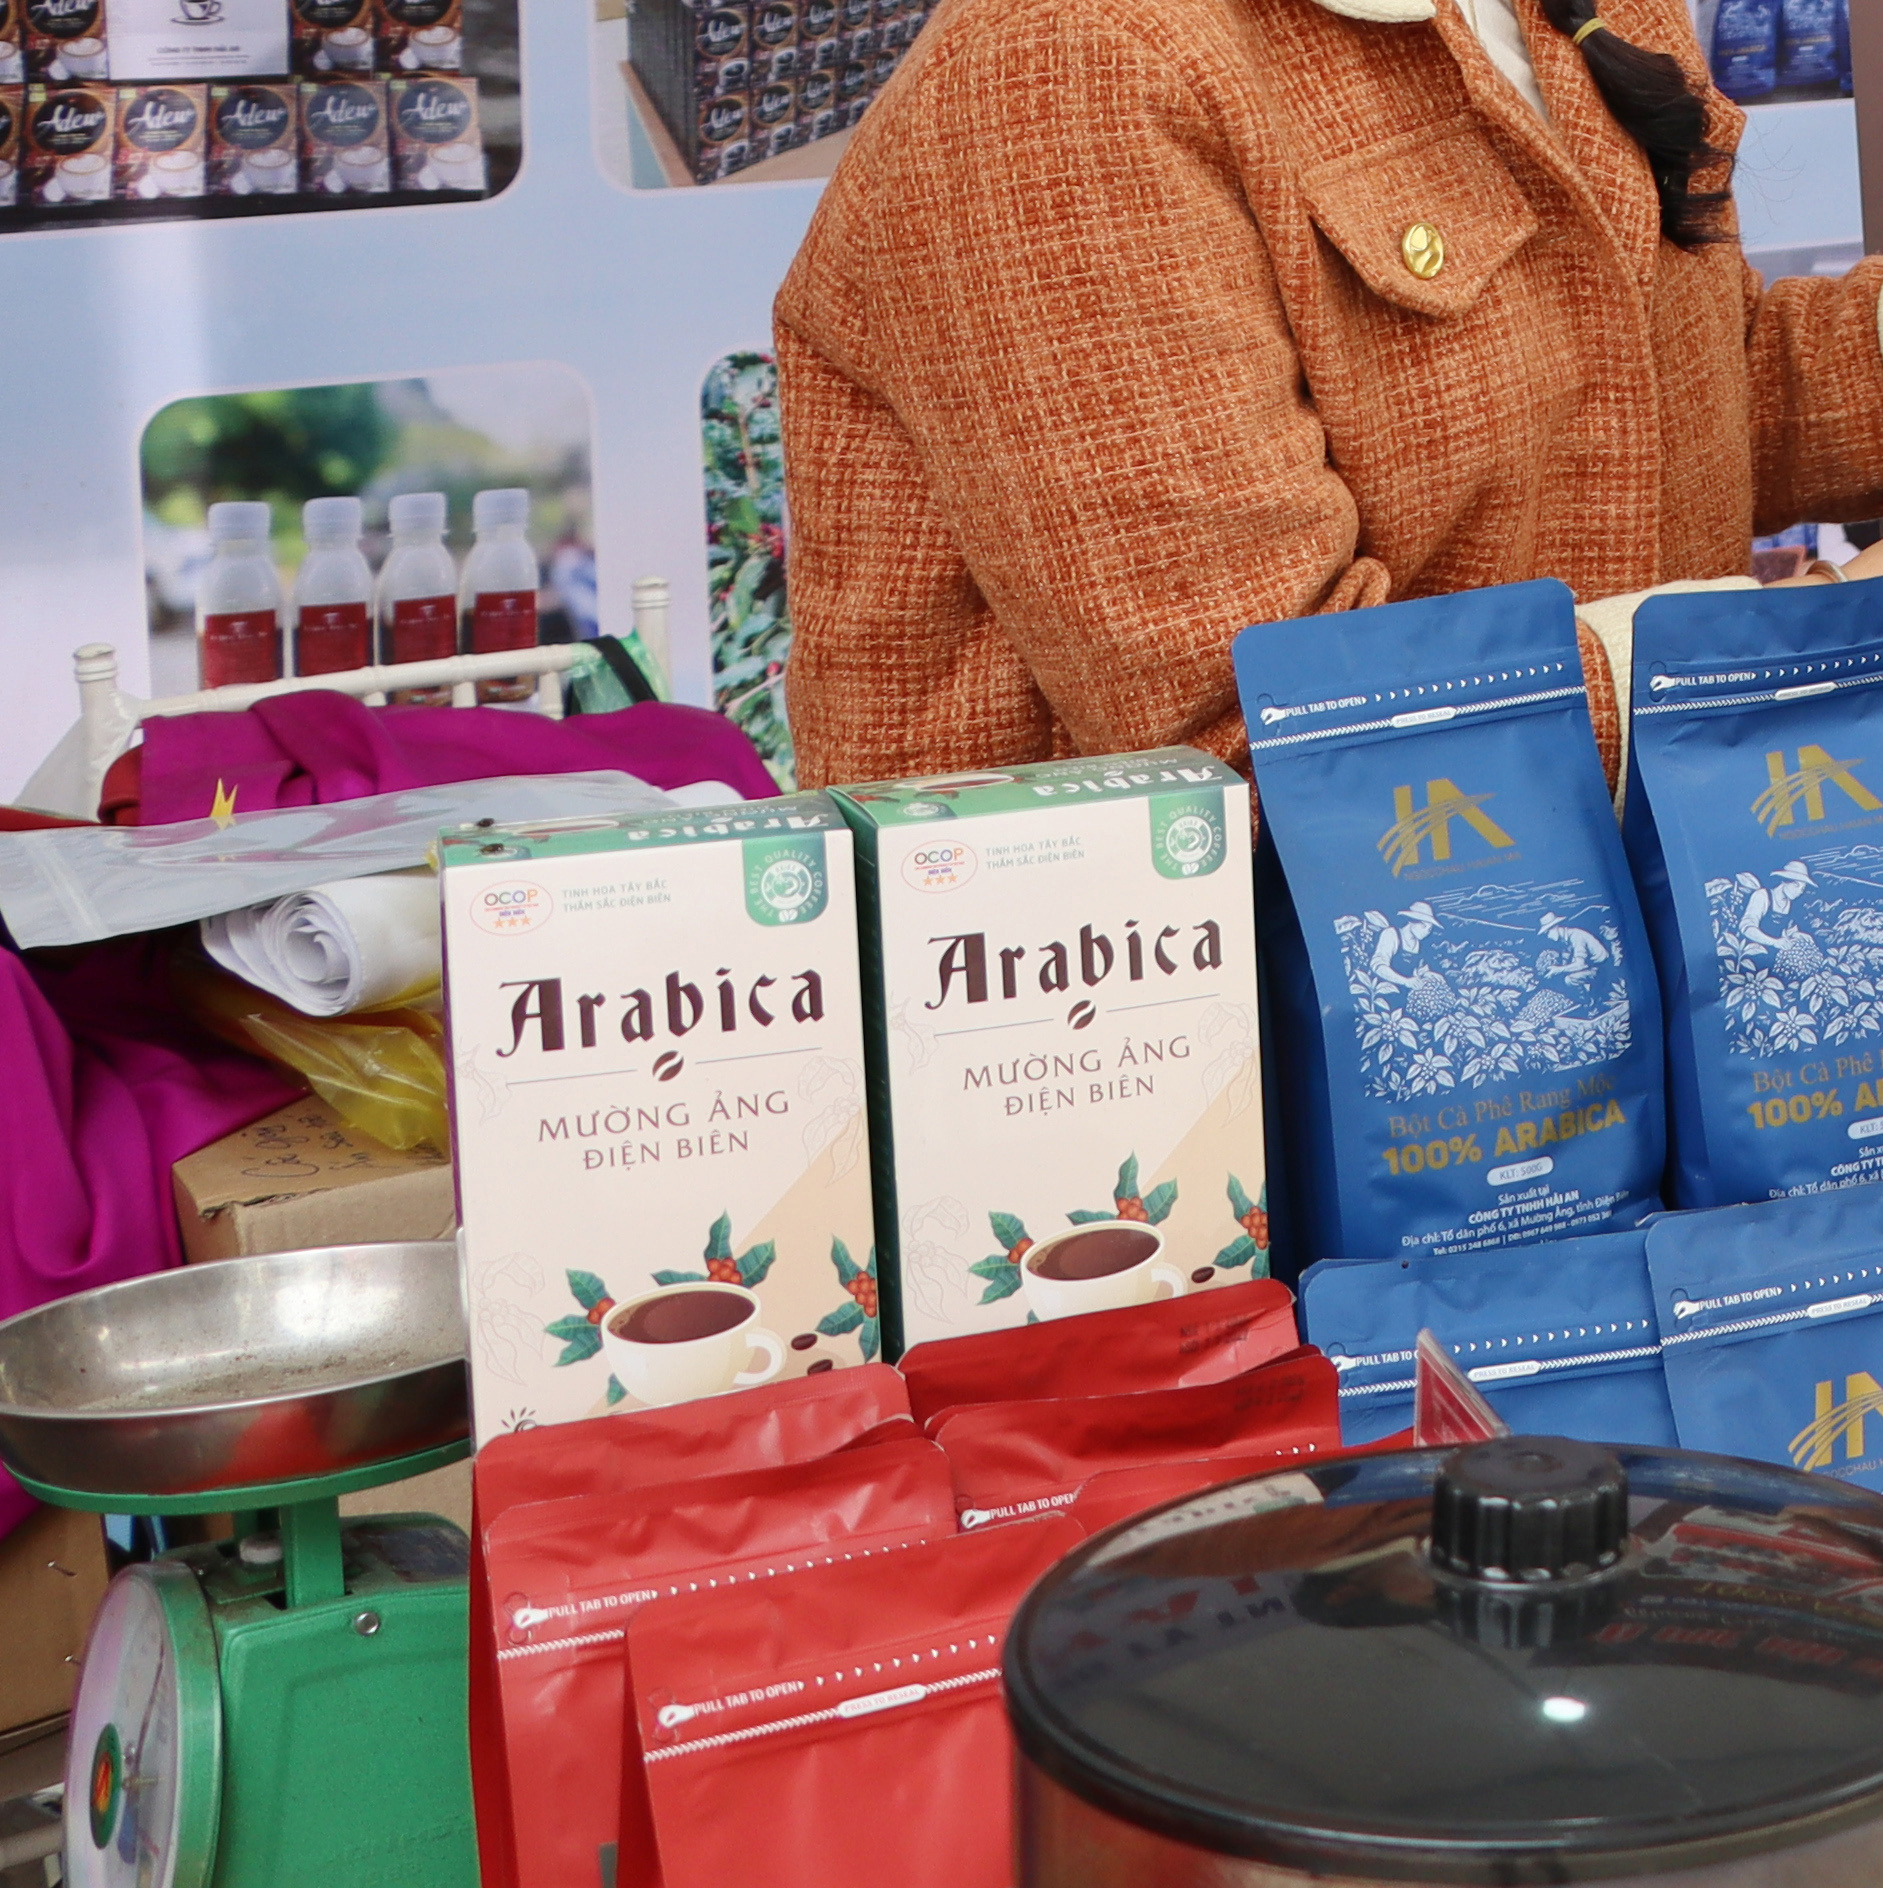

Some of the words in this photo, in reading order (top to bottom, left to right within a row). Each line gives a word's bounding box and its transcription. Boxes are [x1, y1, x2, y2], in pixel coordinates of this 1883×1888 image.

[1286, 705, 1307, 716] PULL
[1308, 703, 1324, 712] TAB
[1326, 701, 1337, 710] TO
[484, 888, 539, 907] OCOP
[924, 919, 1223, 1010] Arabica
[496, 967, 825, 1058] Arabica
[963, 1050, 1101, 1091] MƯỜNG
[1118, 1036, 1191, 1068] ẢNG
[538, 1102, 691, 1142] MƯỜNG
[708, 1090, 789, 1122] ẢNG
[1004, 1087, 1075, 1116] ĐIỆN
[1089, 1074, 1155, 1103] BIÊN
[1748, 1088, 1843, 1129] 100%
[584, 1140, 661, 1170] ĐIỆN
[677, 1130, 749, 1159] BIÊN
[1382, 1134, 1482, 1176] 100%
[1494, 1099, 1626, 1156] ARABICA
